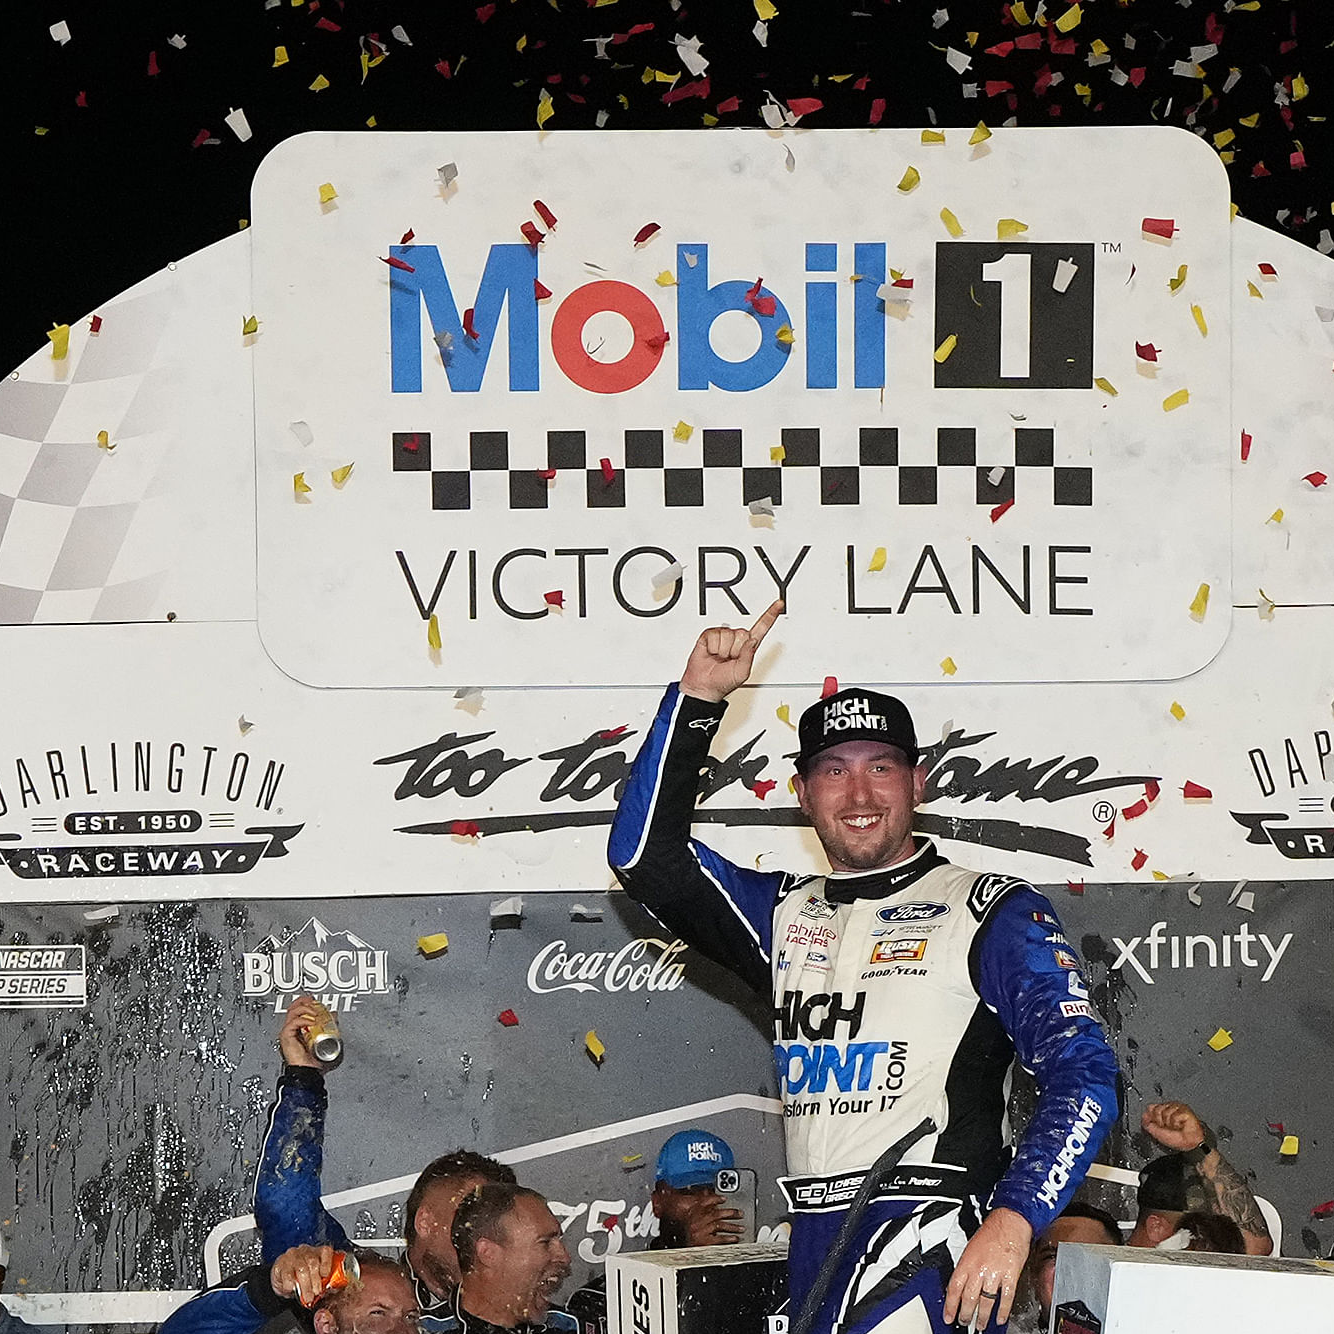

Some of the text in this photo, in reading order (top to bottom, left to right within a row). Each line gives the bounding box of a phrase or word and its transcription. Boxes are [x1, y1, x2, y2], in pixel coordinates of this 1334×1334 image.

[389, 242, 1031, 393] Mobil 1
[395, 544, 1094, 620] VICTORY LANE
[824, 698, 870, 720] HIGH
[823, 714, 881, 736] POINT
[75, 812, 192, 832] EST. 1950
[39, 849, 234, 875] RACEWAY
[890, 904, 937, 920] Ford
[880, 940, 921, 955] RUSH
[1111, 921, 1293, 985] xfinity
[242, 950, 390, 995] BUSCH
[527, 938, 687, 995] Coca-Cola
[13, 975, 68, 995] SERIES
[773, 990, 867, 1041] HIGH
[773, 1041, 889, 1095] POINT
[828, 1095, 902, 1115] Your IT
[687, 1141, 714, 1154] HIGH
